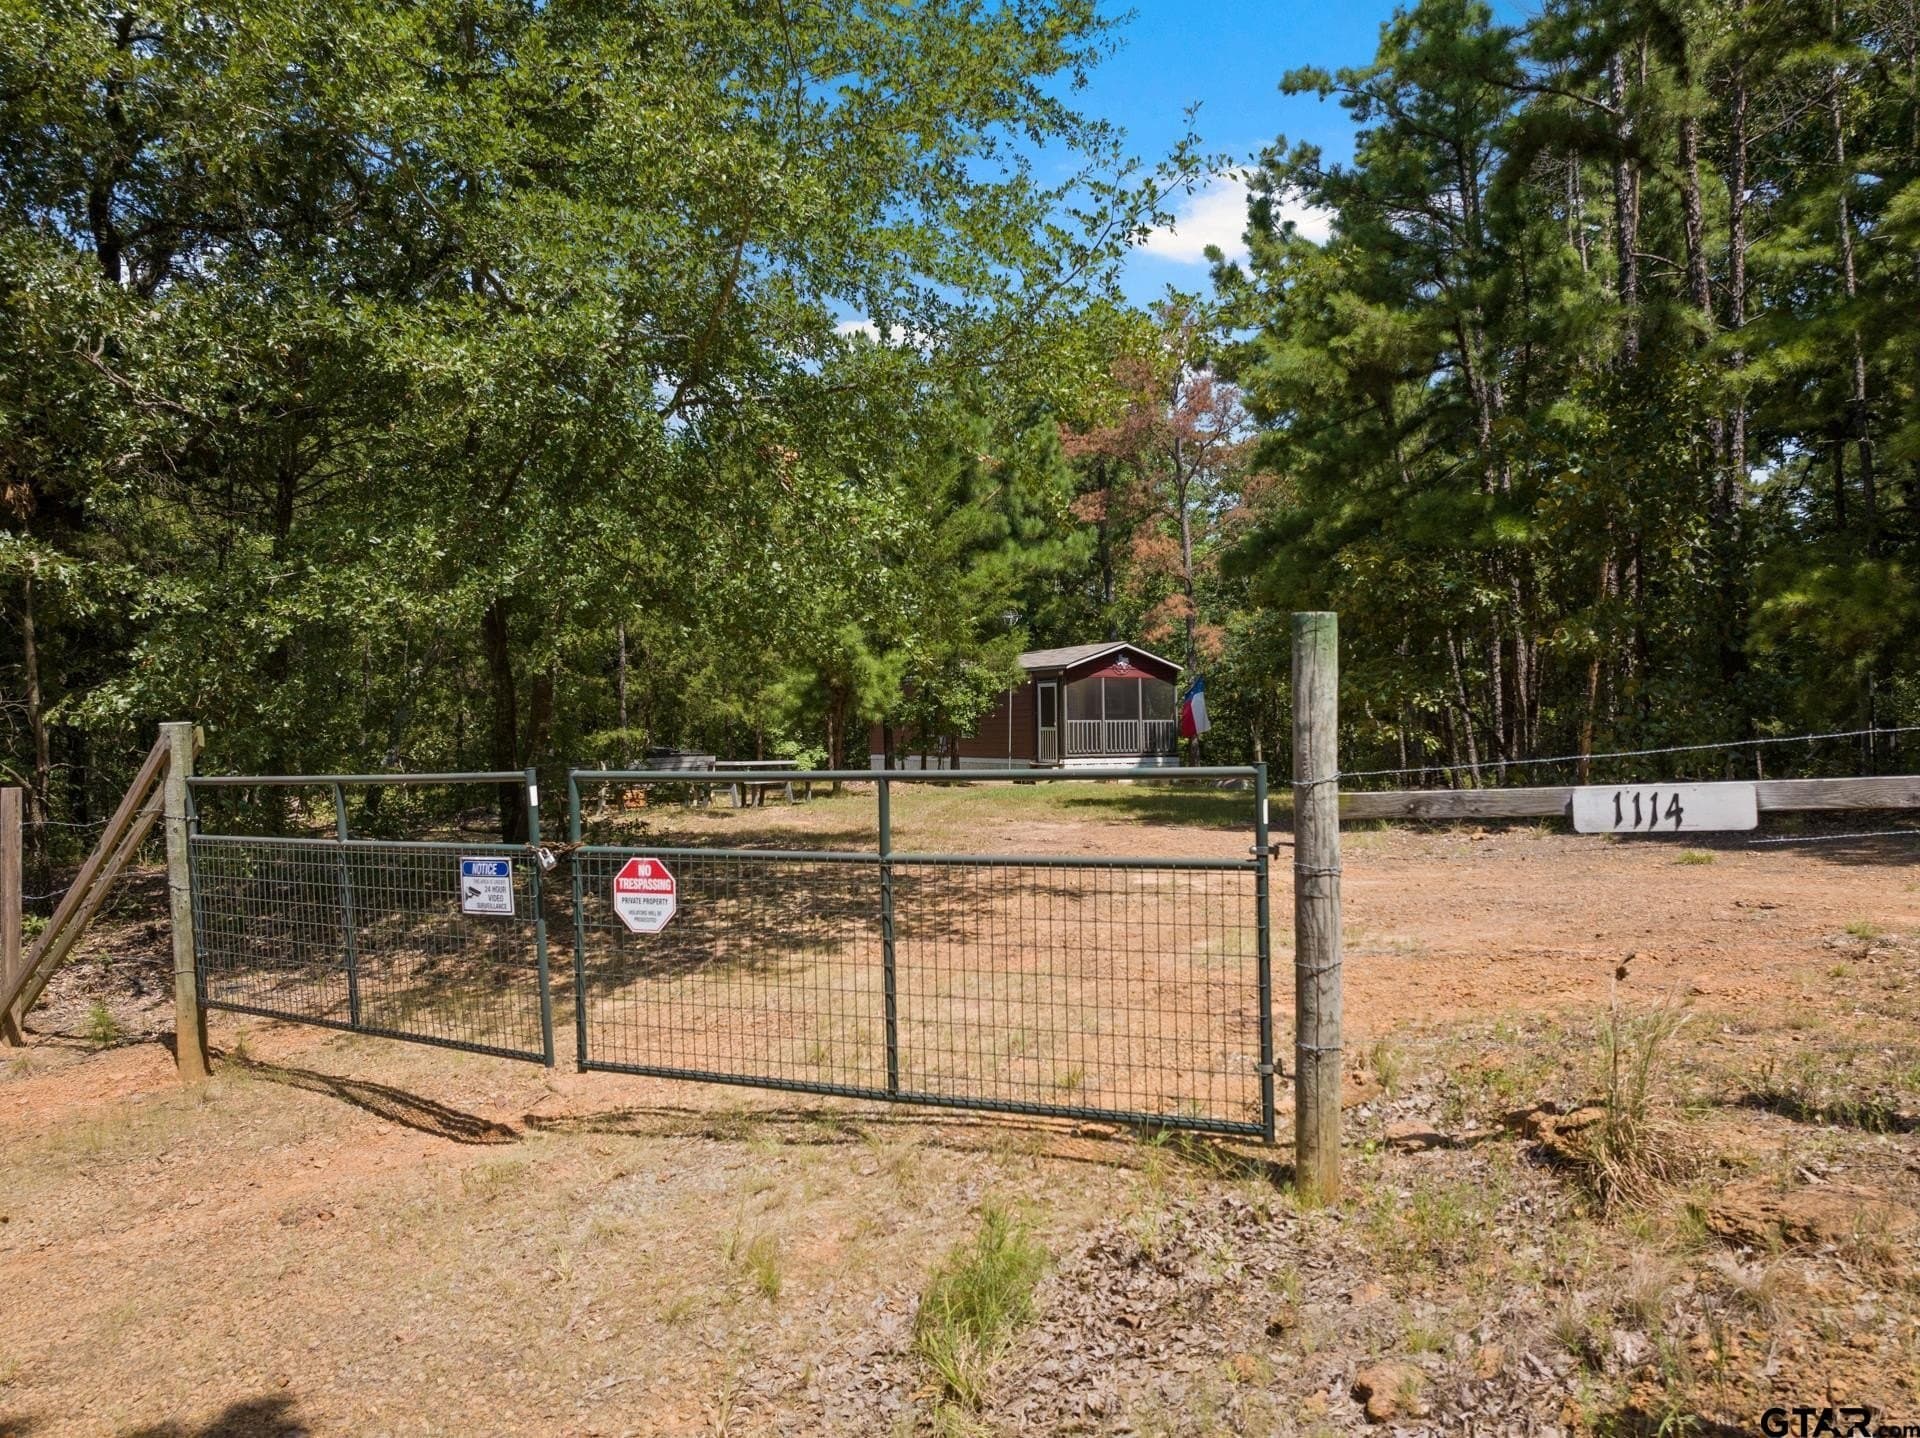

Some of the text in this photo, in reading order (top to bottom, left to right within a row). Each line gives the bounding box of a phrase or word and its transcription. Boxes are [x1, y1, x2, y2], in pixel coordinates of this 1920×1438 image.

[1612, 791, 1684, 831] 1114
[472, 863, 498, 875] NOTICE
[638, 864, 652, 877] NO
[619, 878, 672, 891] TRESPASSING
[488, 894, 504, 902] VIDEO
[621, 897, 668, 905] PRIVATE PROPERTY
[477, 902, 507, 910] SURVEILLANCE
